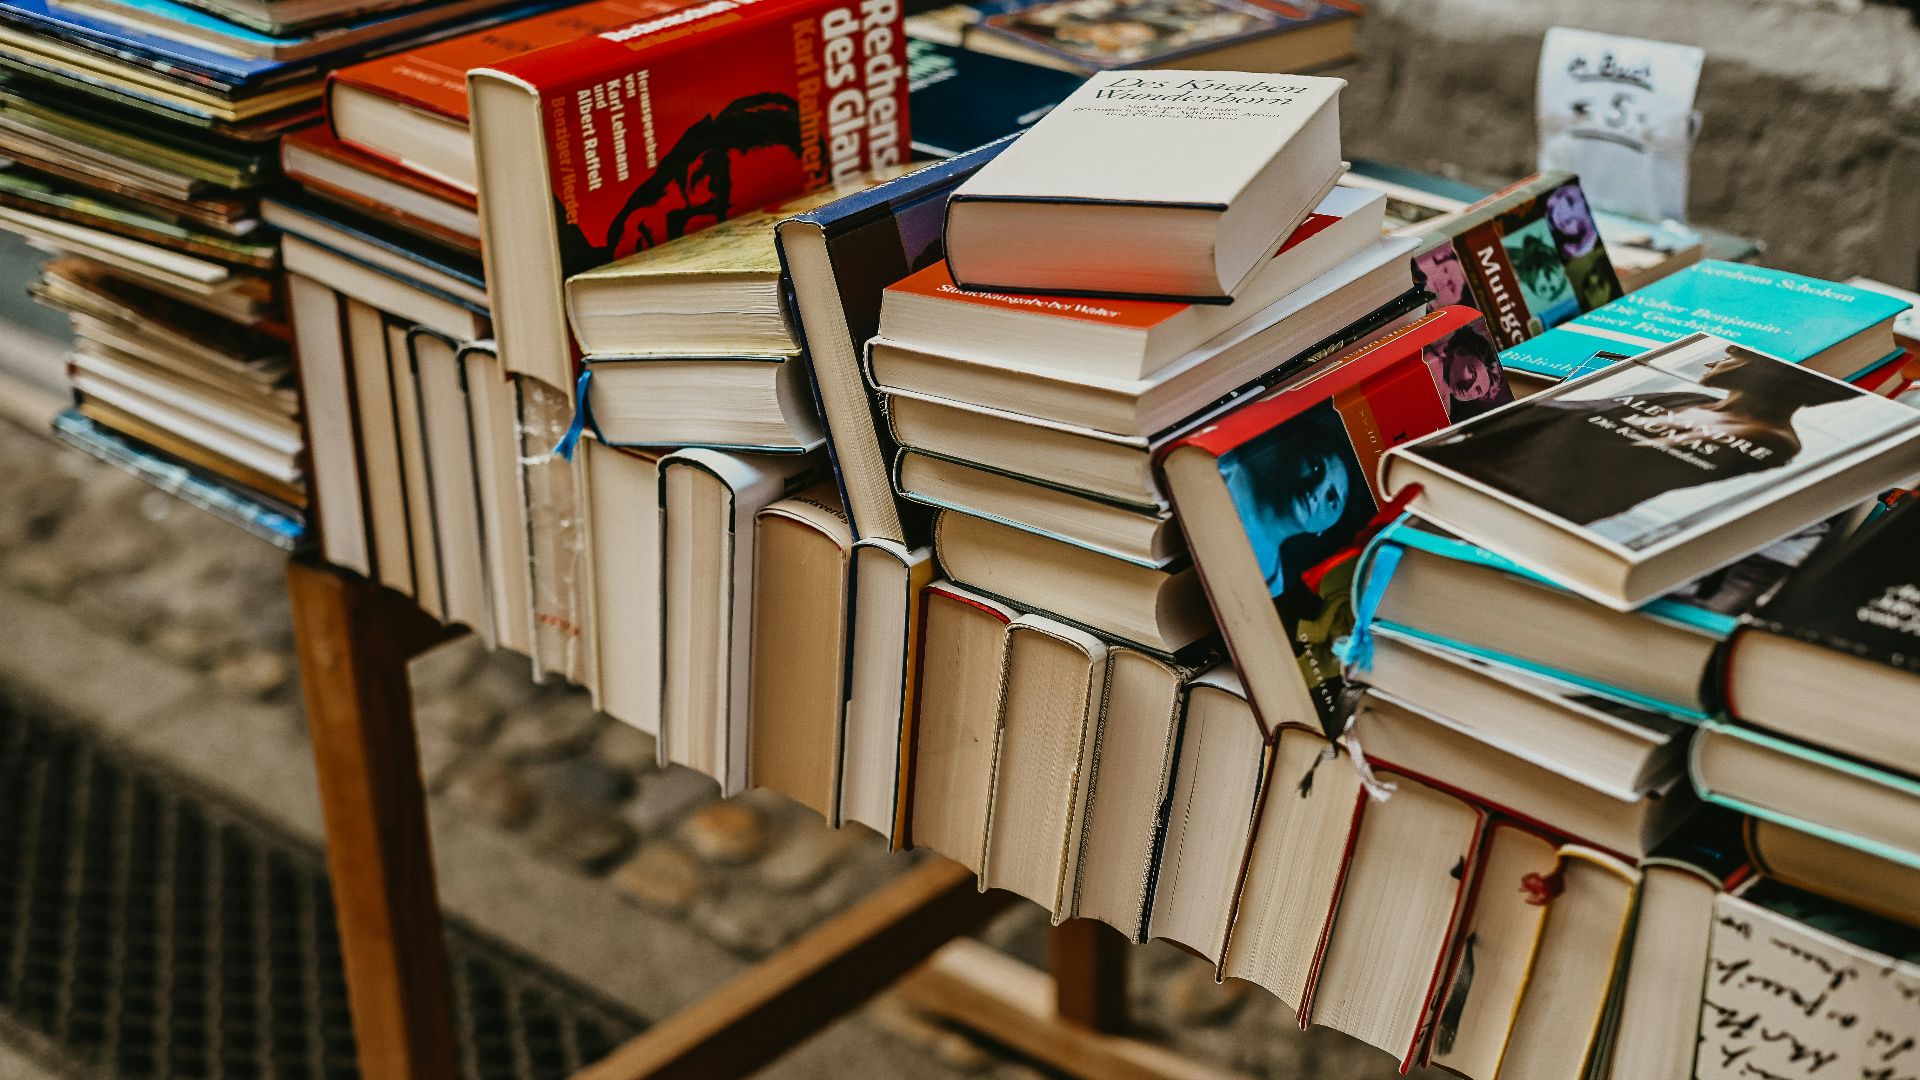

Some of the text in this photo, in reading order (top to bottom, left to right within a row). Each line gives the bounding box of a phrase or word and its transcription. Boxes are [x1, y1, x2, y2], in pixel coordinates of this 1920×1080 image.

[793, 19, 820, 76] Karl
[821, 7, 859, 89] des
[593, 84, 608, 110] und
[624, 73, 636, 99] von
[637, 69, 658, 169] Herausgegeben
[1104, 78, 1308, 94] Des Knaben
[577, 89, 602, 192] Albert Raffelt
[607, 79, 629, 182] Karl Lehmann
